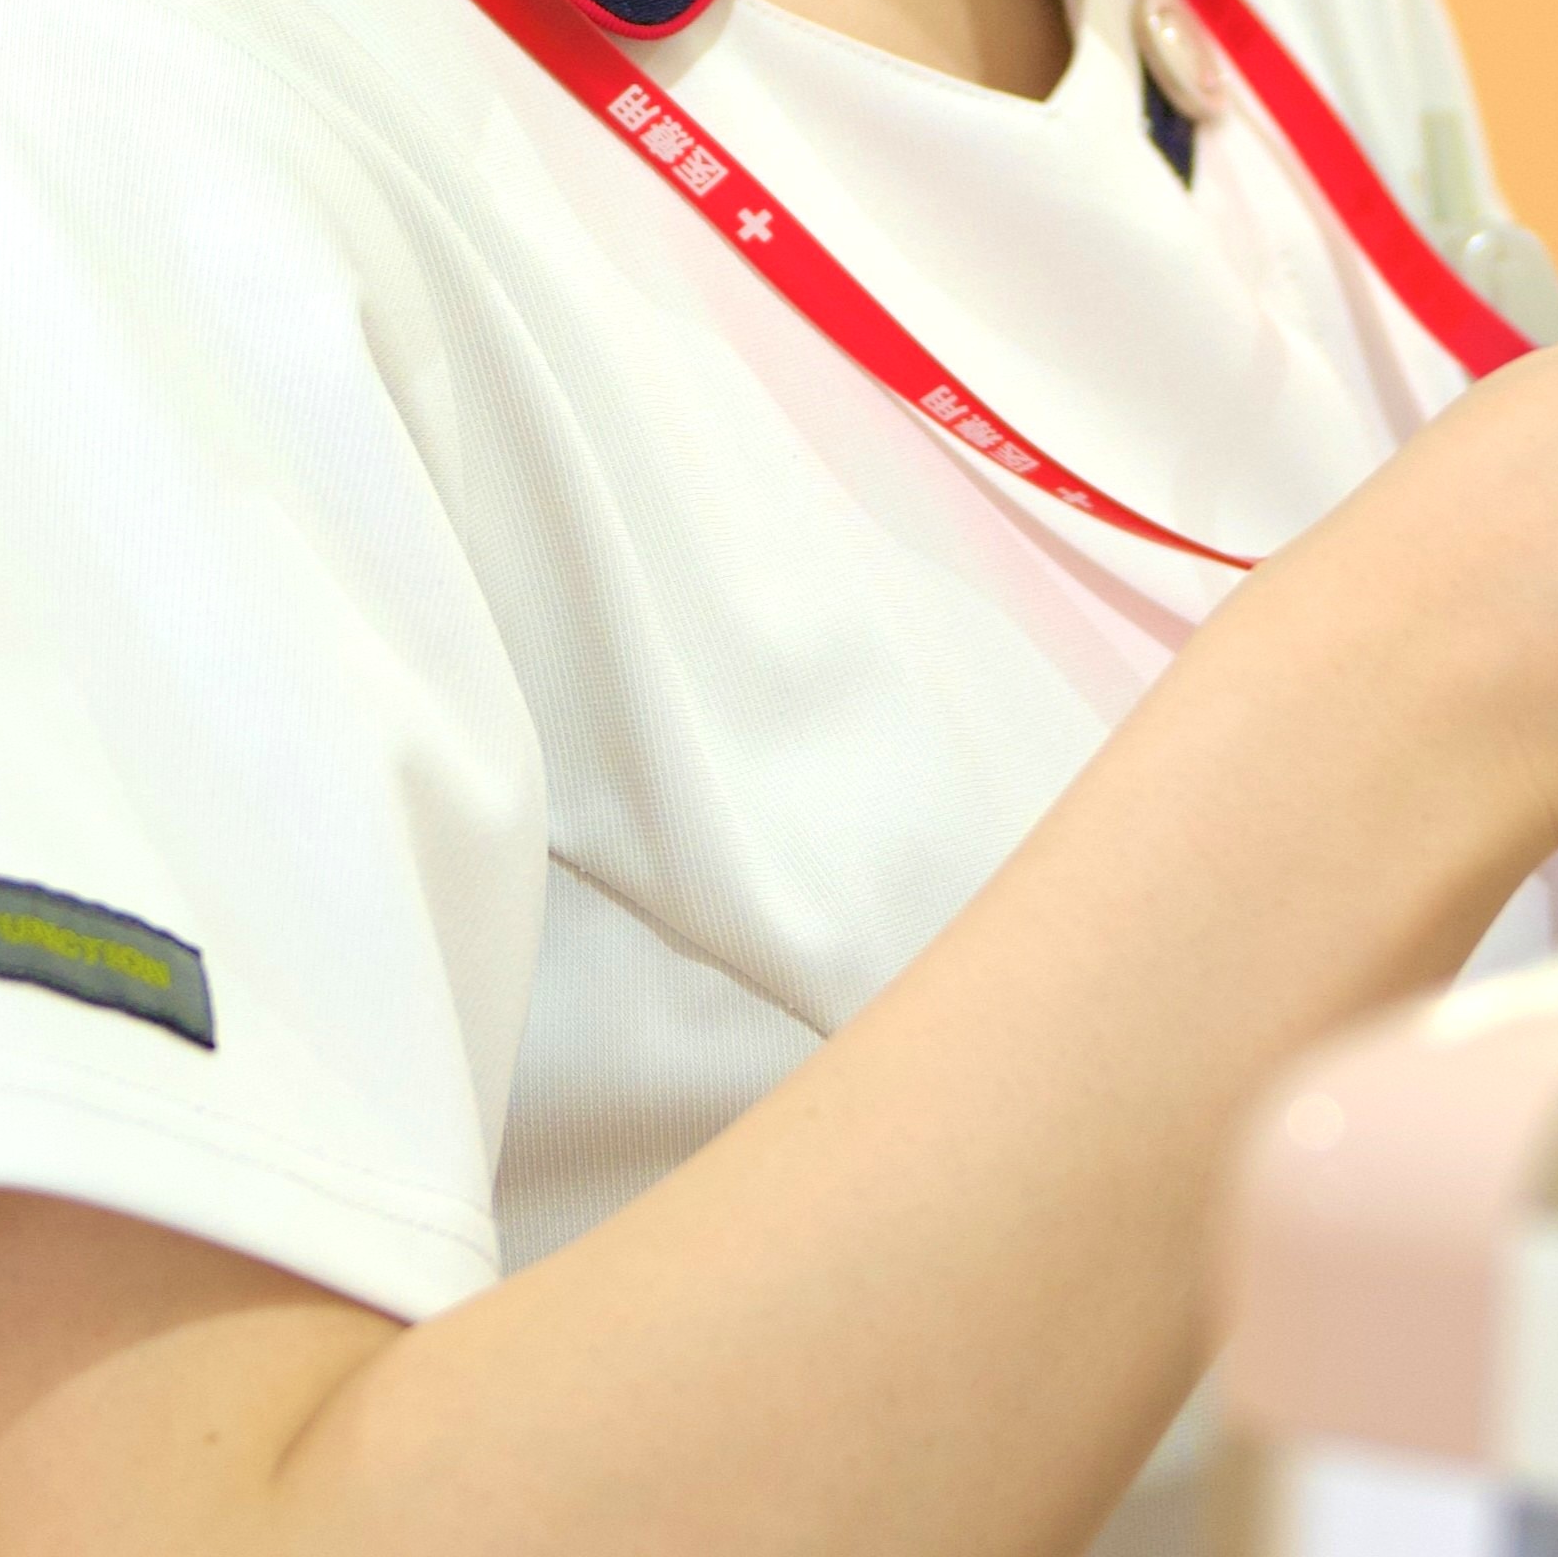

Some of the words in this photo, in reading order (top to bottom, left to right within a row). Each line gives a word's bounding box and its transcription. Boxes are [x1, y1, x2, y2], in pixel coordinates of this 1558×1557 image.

[607, 83, 729, 197] 医療用
[920, 384, 1041, 473] 医療用
